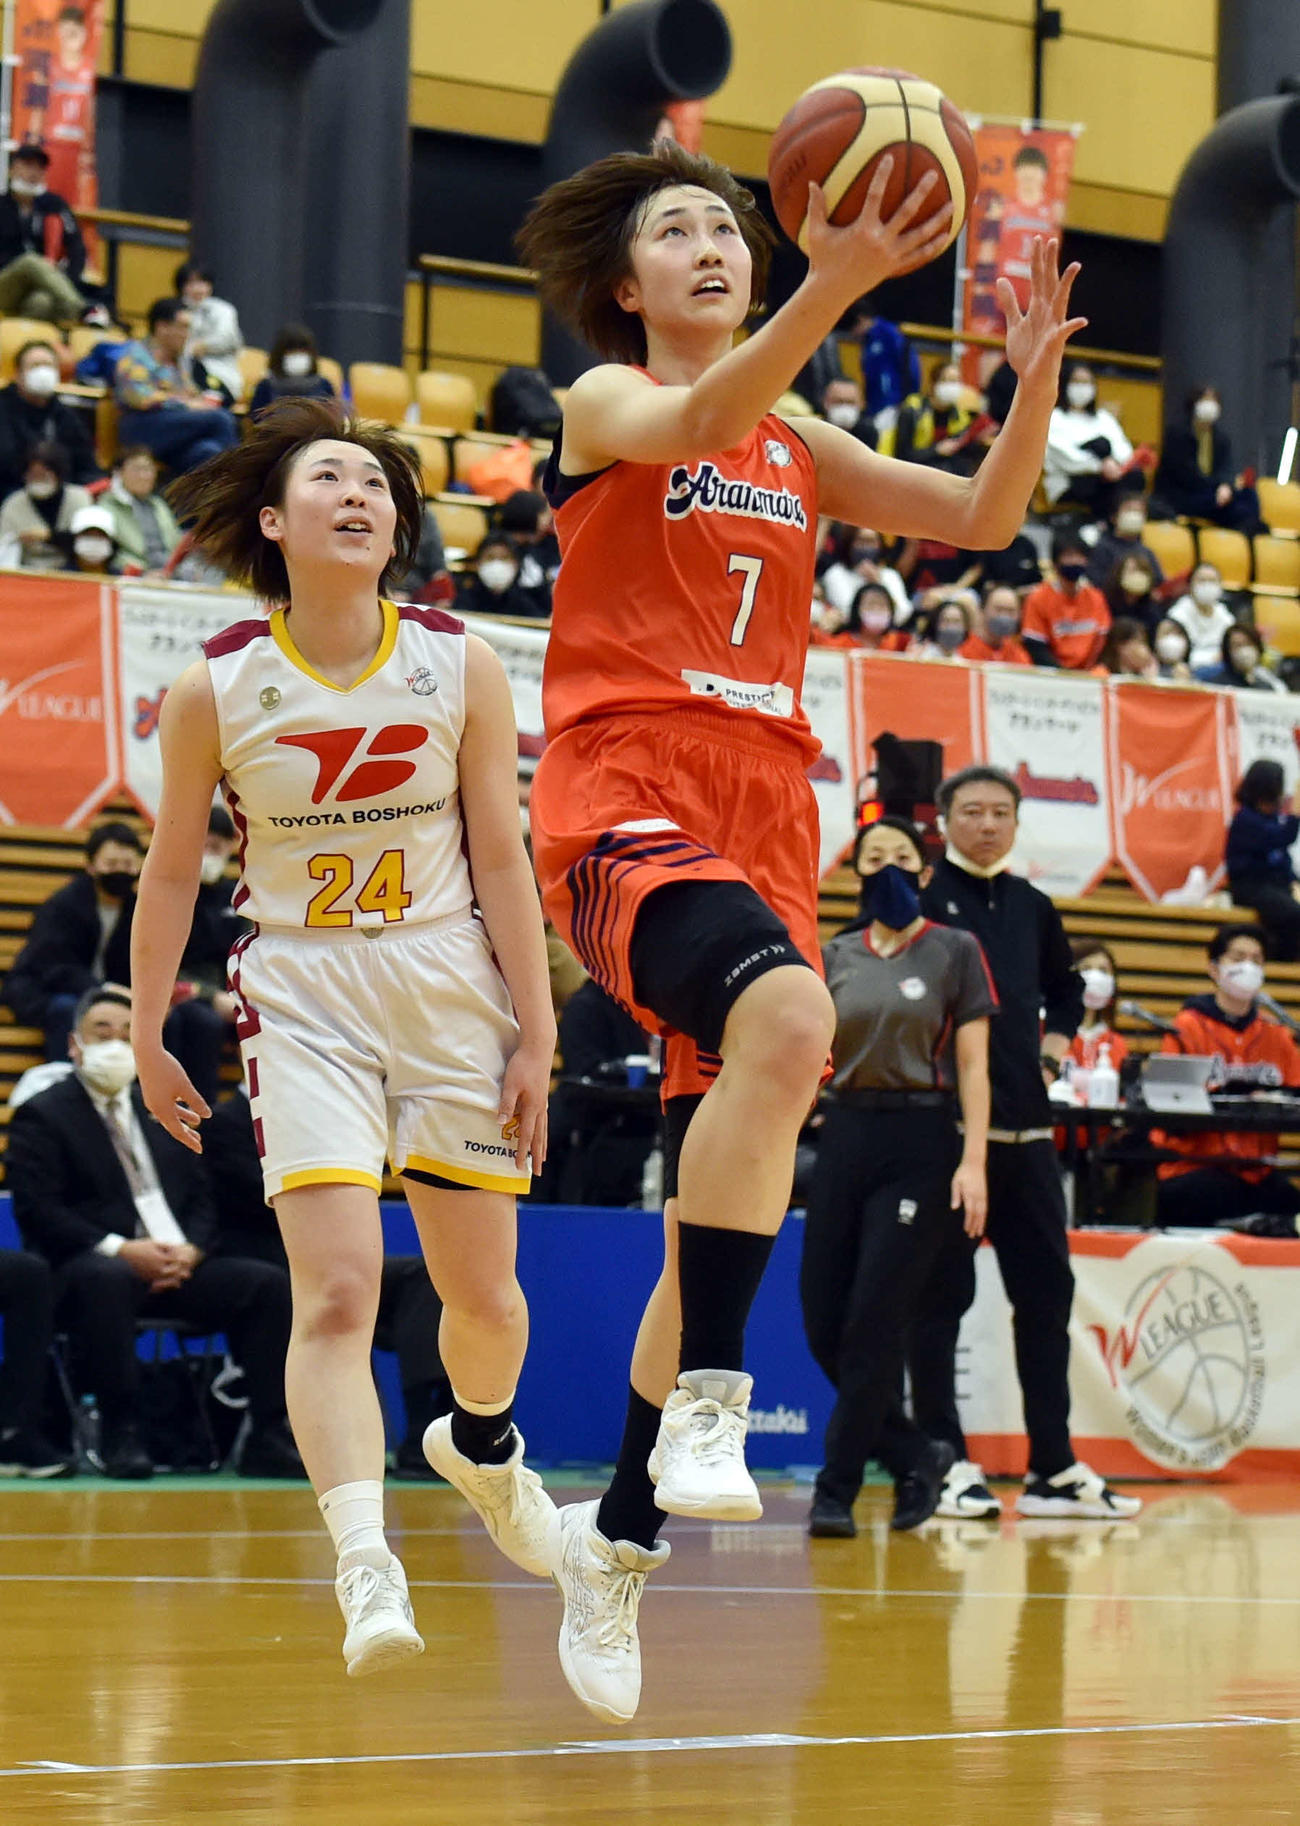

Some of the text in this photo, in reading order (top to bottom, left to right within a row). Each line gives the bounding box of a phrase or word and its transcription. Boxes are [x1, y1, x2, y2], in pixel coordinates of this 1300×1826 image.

[727, 552, 765, 648] 7
[268, 797, 446, 828] TOYOTA BOSHOKU
[304, 849, 412, 928] 24
[464, 1140, 507, 1158] TOYOTA
[1140, 1291, 1226, 1358] LEAGUE
